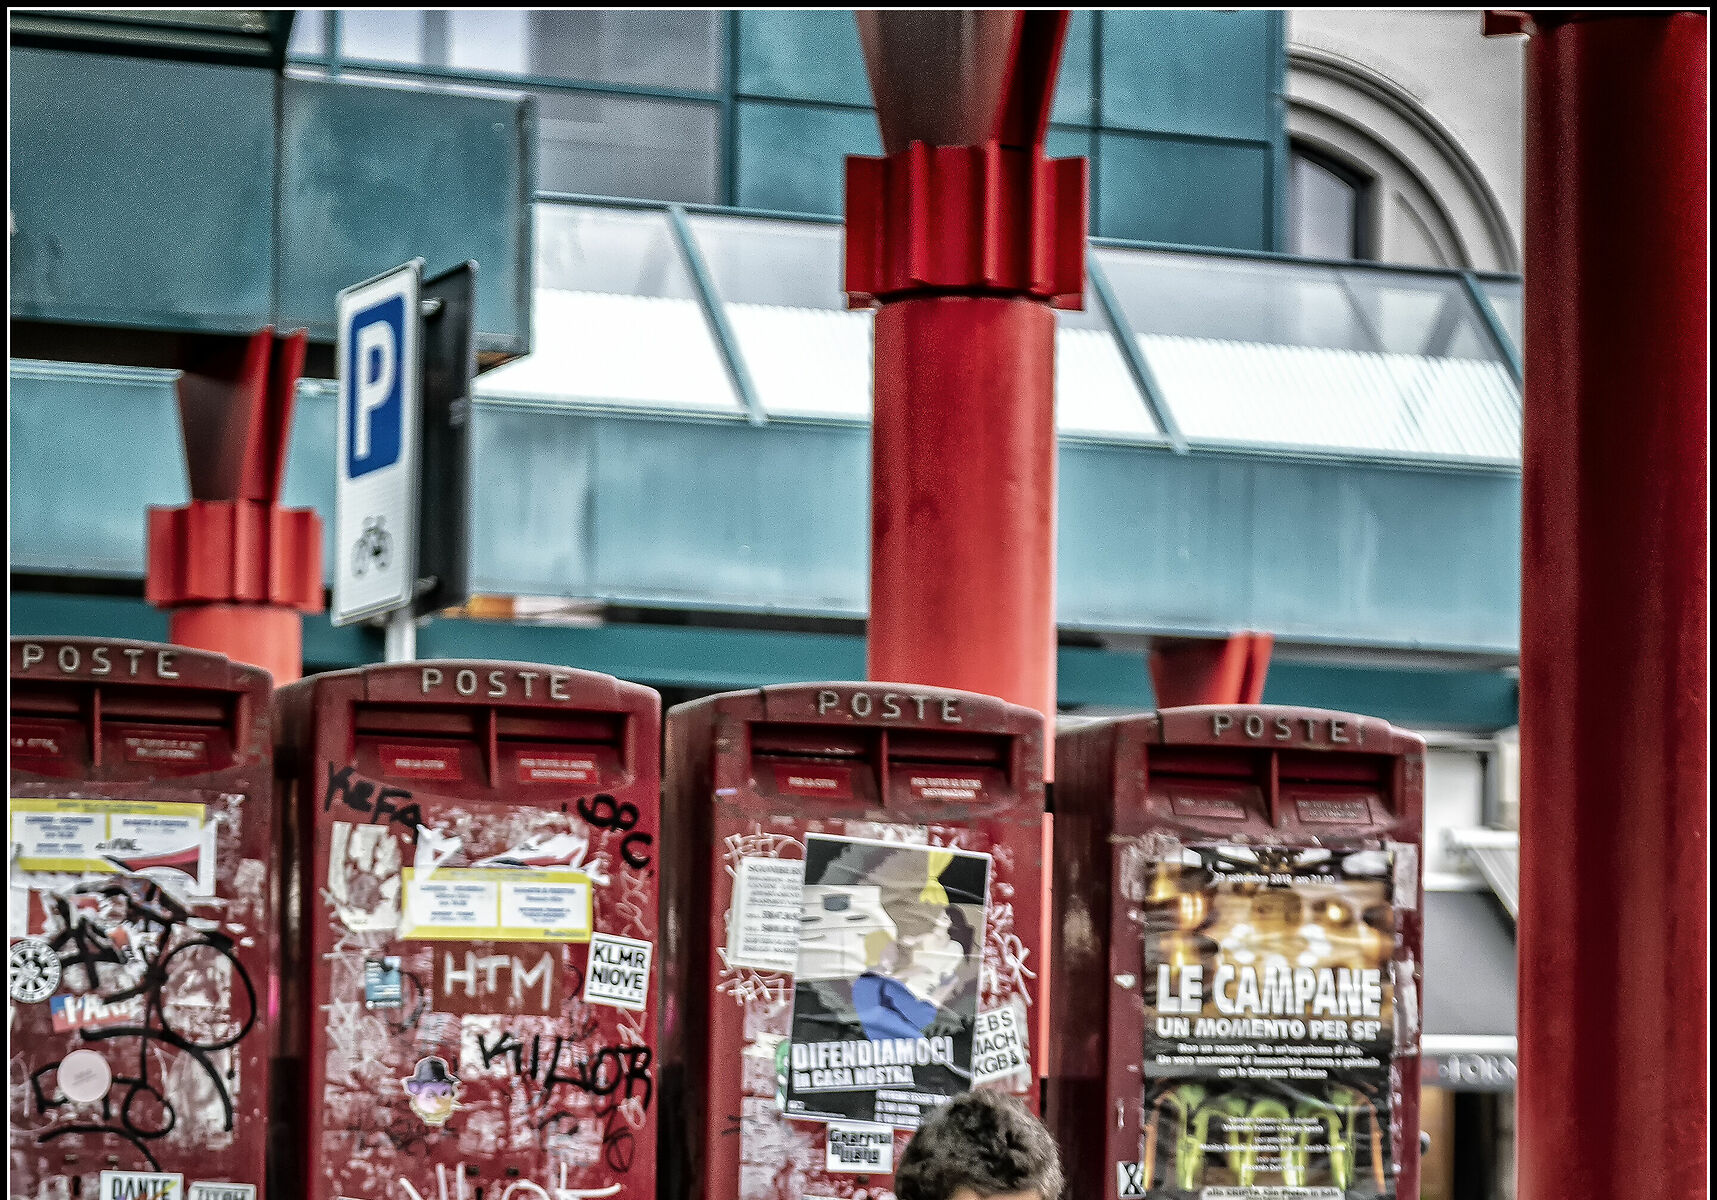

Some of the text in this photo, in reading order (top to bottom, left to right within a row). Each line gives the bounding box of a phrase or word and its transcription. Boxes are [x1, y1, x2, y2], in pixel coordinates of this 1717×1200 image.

[353, 320, 397, 460] P
[22, 644, 180, 679] POSTE
[421, 668, 571, 701] POSTE
[817, 690, 963, 724] POSTE
[1212, 713, 1350, 743] POSTE
[593, 943, 646, 969] KLMR
[1157, 964, 1382, 1017] LE CAMPANE
[1156, 1017, 1190, 1038] UN
[1195, 1018, 1306, 1040] MOMENTO
[1308, 1020, 1348, 1040] PER
[792, 1036, 954, 1071] DIFENDIAMOCI
[811, 1068, 854, 1087] CASA
